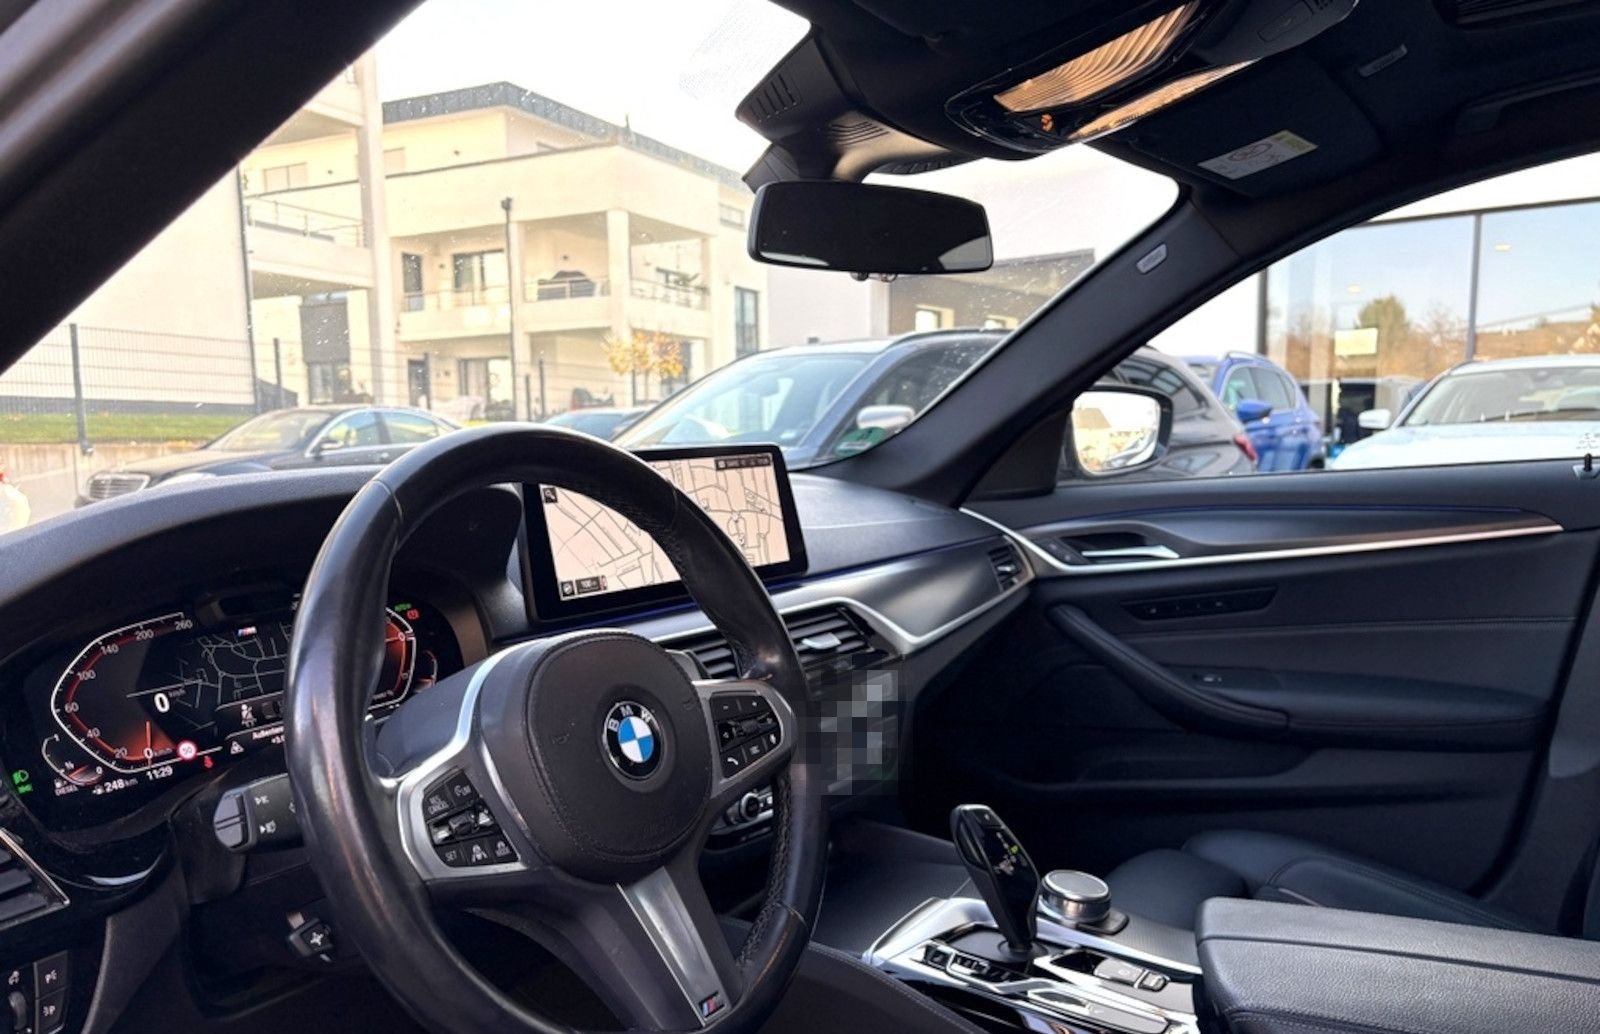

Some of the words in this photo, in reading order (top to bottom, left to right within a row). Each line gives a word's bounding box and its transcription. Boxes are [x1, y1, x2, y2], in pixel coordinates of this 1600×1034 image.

[174, 619, 193, 631] 260
[135, 629, 154, 641] 200
[101, 643, 119, 655] 140
[77, 670, 96, 681] 100
[64, 702, 79, 713] 60
[154, 693, 170, 713] 0
[608, 705, 653, 733] BMW
[87, 728, 100, 738] 40
[115, 747, 128, 758] 20
[143, 748, 154, 759] 0
[96, 766, 103, 775] 0
[104, 778, 125, 793] 248
